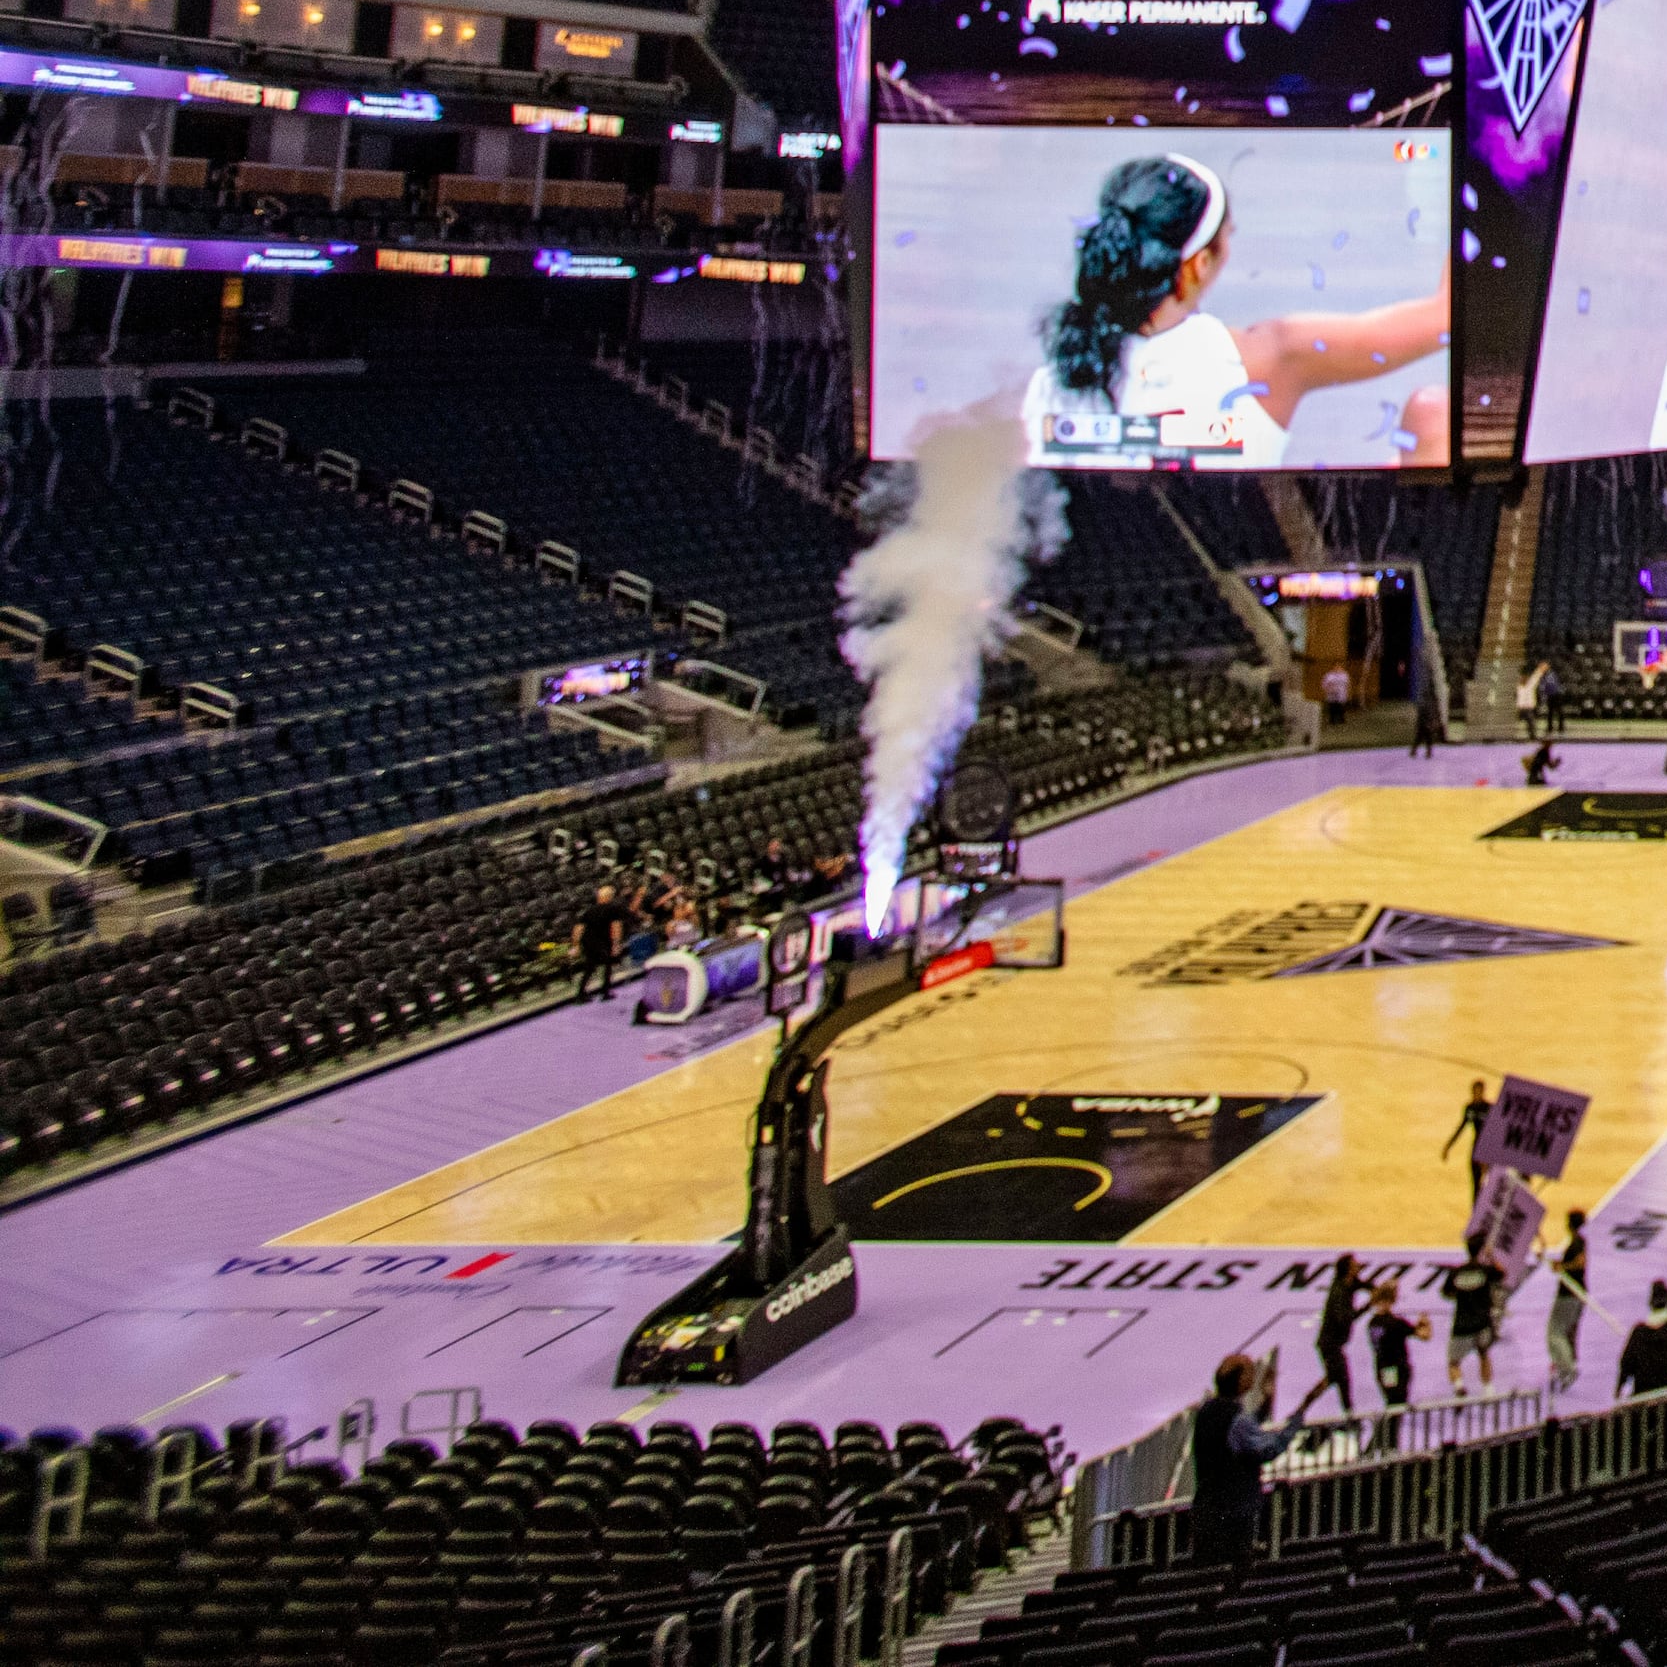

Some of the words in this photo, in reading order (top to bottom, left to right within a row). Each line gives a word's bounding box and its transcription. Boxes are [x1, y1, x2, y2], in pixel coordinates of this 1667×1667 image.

[214, 1254, 450, 1277] ULTRA
[1020, 1259, 1257, 1291] STATE
[766, 1256, 854, 1323] coinbase
